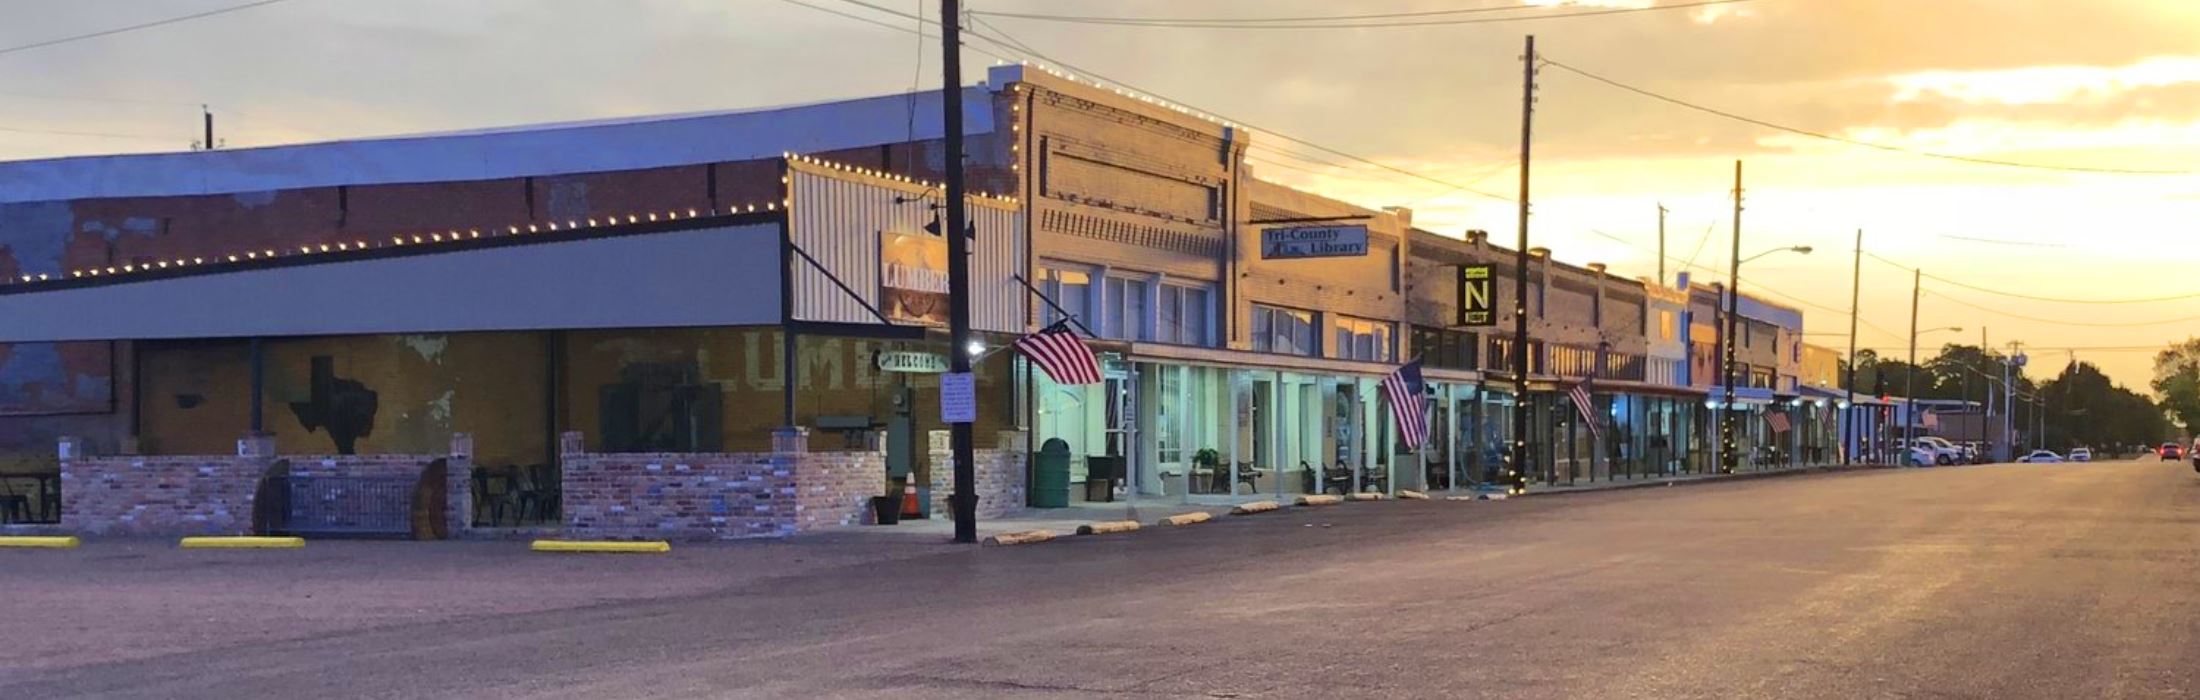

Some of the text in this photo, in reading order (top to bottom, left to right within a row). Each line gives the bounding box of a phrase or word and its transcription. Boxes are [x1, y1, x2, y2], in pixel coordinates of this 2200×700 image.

[1267, 228, 1339, 243] Tri-County
[1310, 242, 1363, 254] Library
[881, 261, 950, 294] LUMBER
